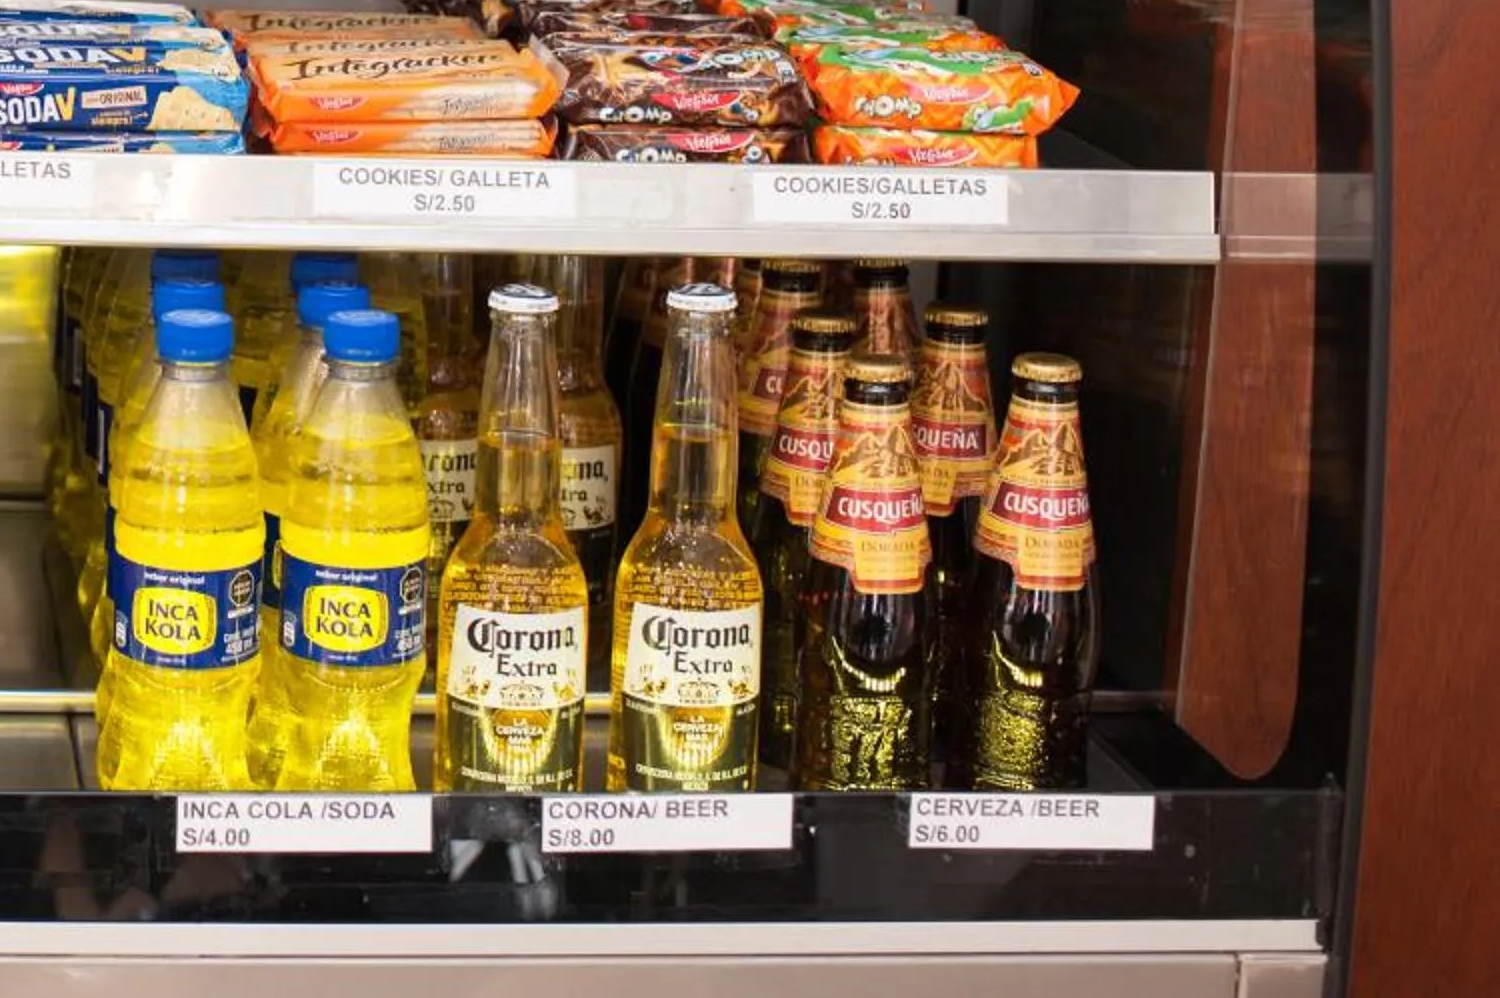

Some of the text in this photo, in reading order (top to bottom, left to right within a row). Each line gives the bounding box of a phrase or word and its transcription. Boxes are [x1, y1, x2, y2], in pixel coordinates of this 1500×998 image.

[338, 166, 550, 189] COOKIES/ GALLETA
[773, 175, 988, 197] COOKIES/GALLETAS
[413, 193, 476, 213] S/2.50
[851, 201, 911, 220] S/2.50
[148, 598, 199, 621] INCA
[320, 597, 372, 619] INCA
[145, 618, 202, 641] KOLA
[316, 616, 374, 638] KOLA
[467, 616, 578, 657] Corona
[641, 614, 754, 657] Corona
[497, 654, 557, 678] Extra
[673, 652, 733, 675] Extra
[183, 801, 396, 820] INCA COLA /SODA
[548, 799, 729, 820] CORONA/ BEER
[916, 797, 1100, 818] CERVEZA /BEER
[182, 827, 251, 847] S/4.00
[548, 828, 615, 847] S/8.00
[915, 825, 980, 843] S/6.00
